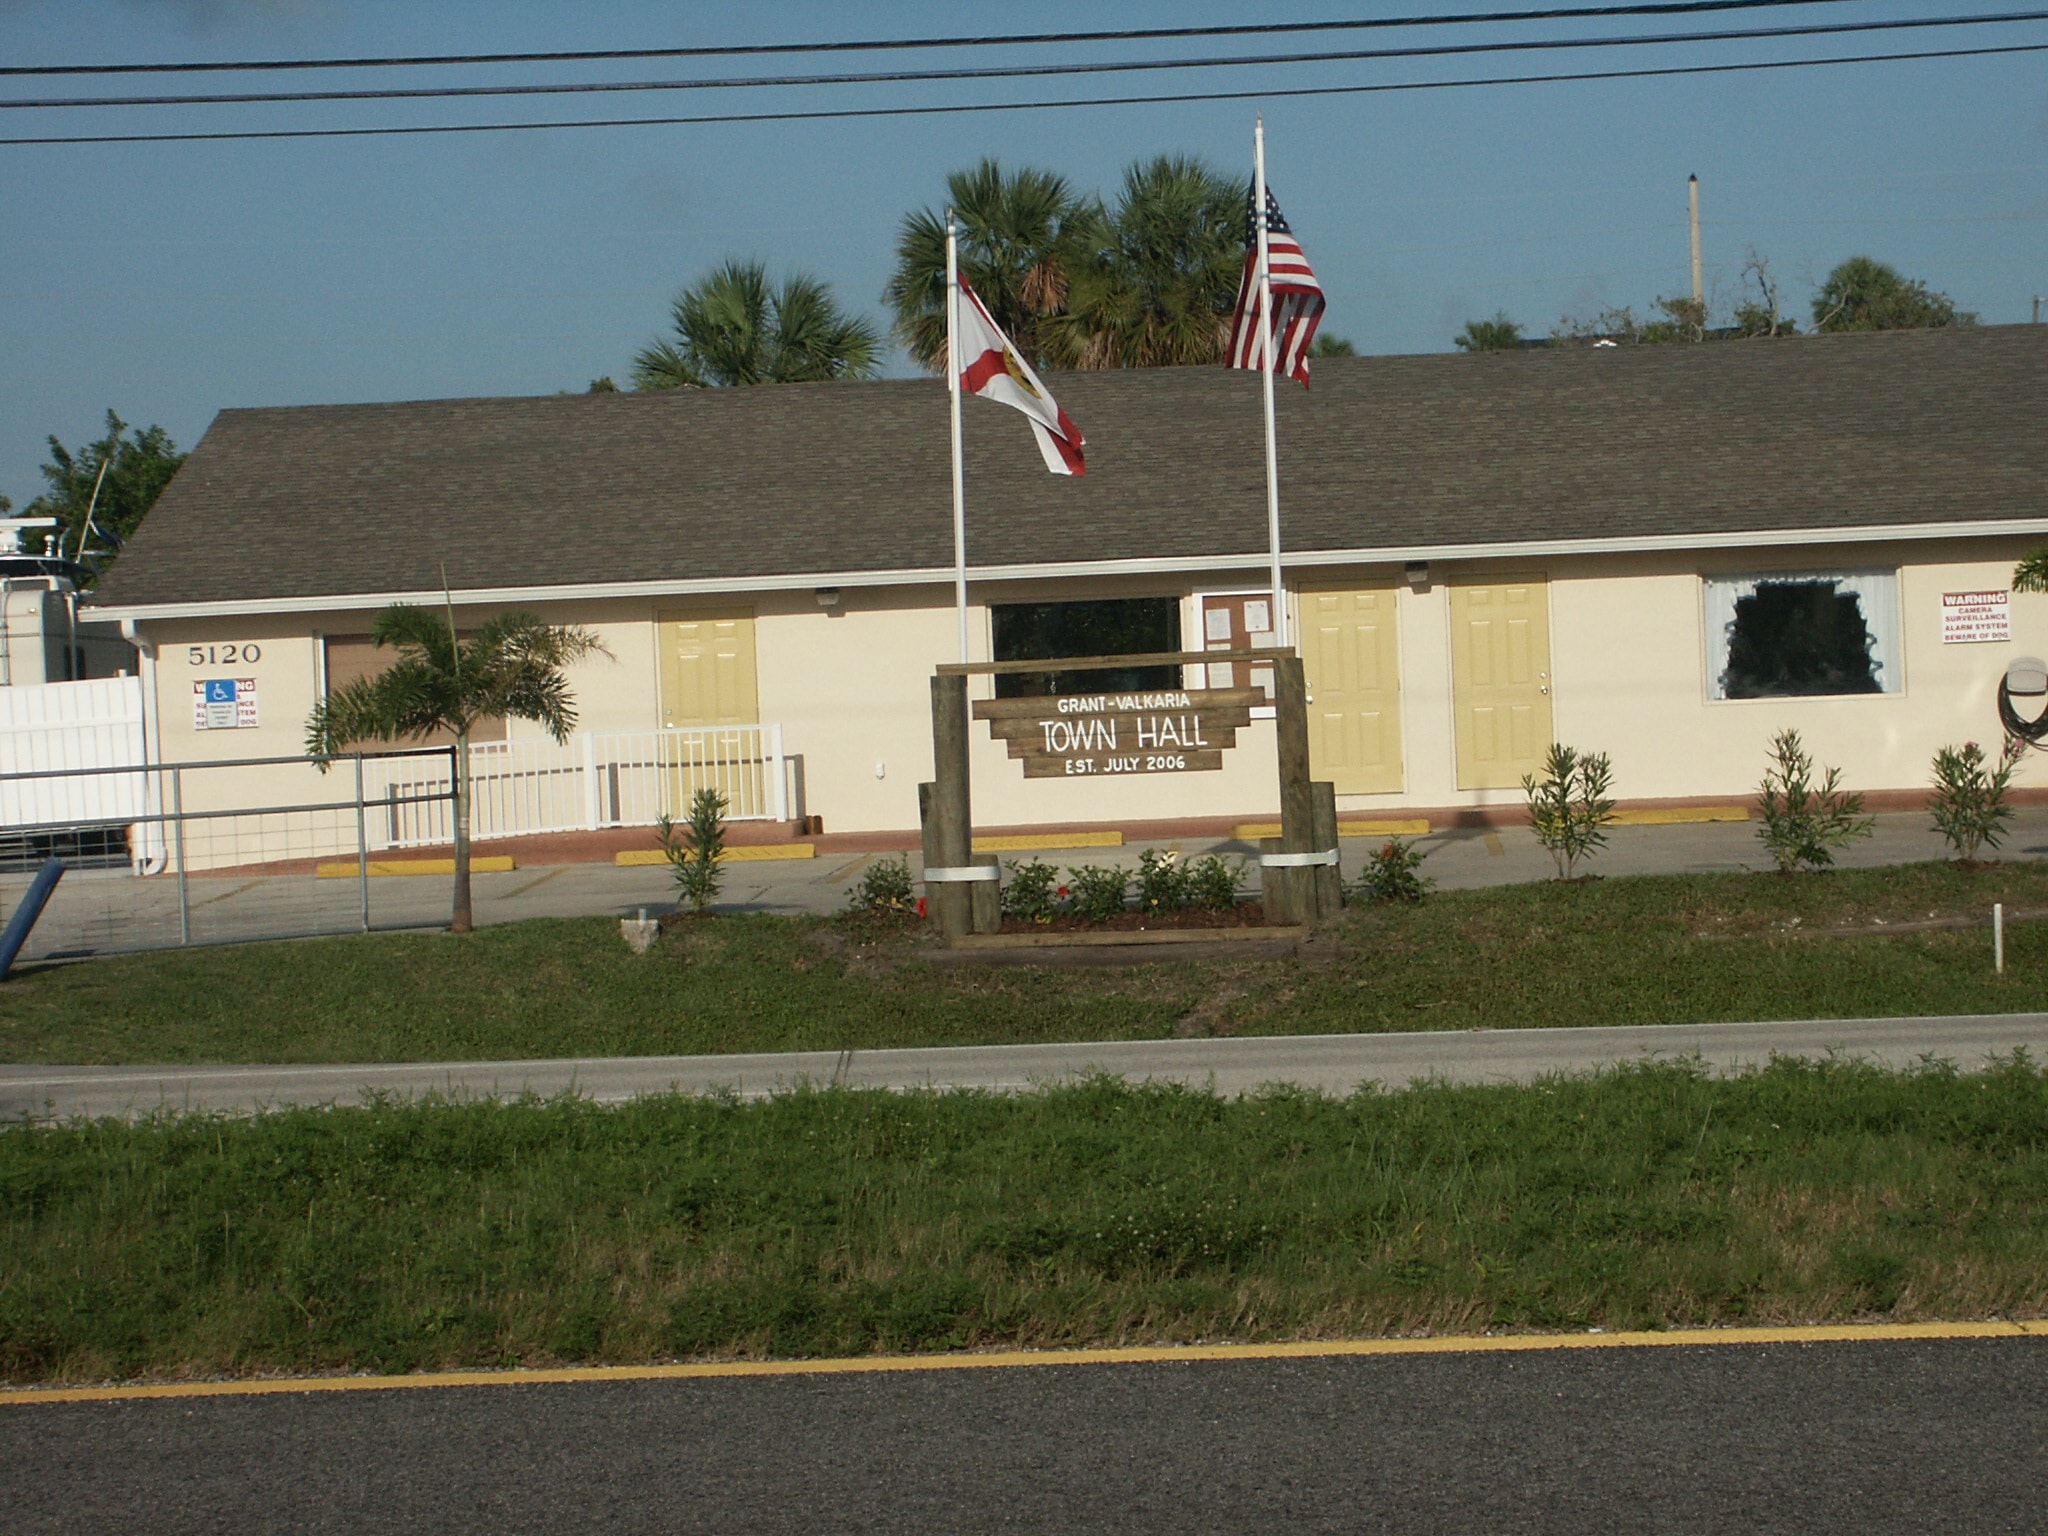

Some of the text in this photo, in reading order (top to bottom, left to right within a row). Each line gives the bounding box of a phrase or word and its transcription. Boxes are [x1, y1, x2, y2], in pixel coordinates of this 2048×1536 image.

[1944, 593, 2006, 606] WARNING
[1958, 606, 1993, 614] CAMERA
[1945, 613, 2007, 622] SURVEILLANCE
[1975, 622, 2008, 630] SYSTEM
[1944, 633, 1977, 641] BEWARE
[188, 643, 262, 666] 5120
[1057, 693, 1191, 713] GRANT-VALKARIA
[1039, 715, 1208, 753] TOWN HALL
[1065, 755, 1186, 775] EST. JULY 2006
